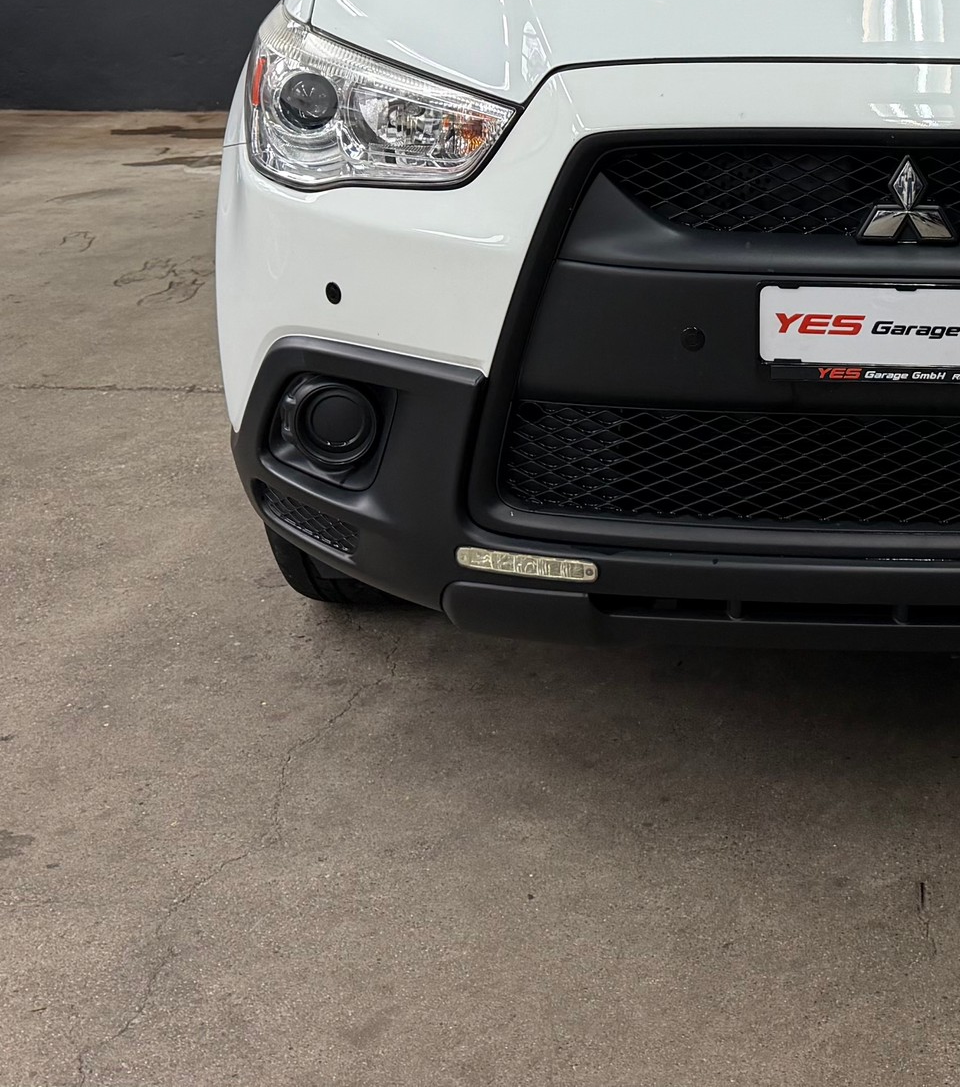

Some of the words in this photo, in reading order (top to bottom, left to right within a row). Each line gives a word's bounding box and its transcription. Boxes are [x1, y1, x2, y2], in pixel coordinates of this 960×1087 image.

[775, 313, 866, 336] YES
[818, 368, 862, 380] YES
[864, 370, 909, 381] Garage
[911, 371, 947, 380] GmbH
